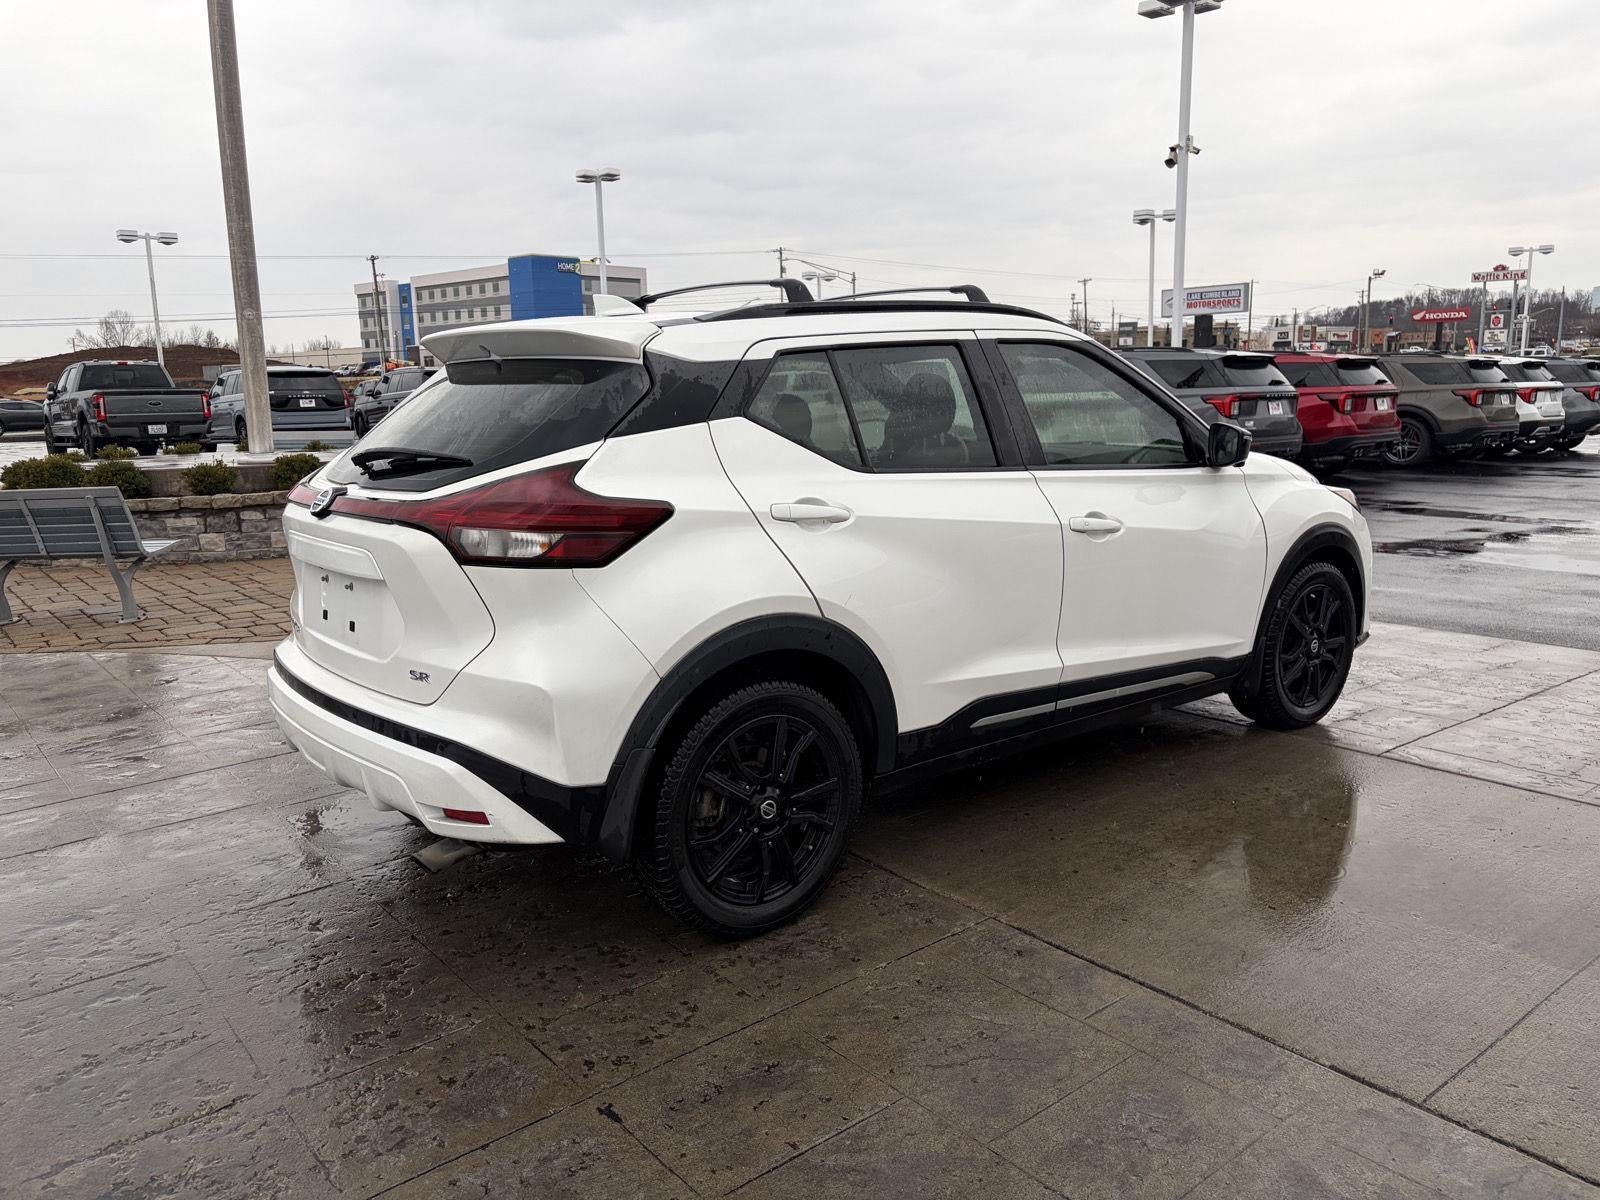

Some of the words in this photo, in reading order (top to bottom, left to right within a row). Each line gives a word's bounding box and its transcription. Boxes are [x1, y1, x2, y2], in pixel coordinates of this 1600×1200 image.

[1473, 272, 1500, 281] Waffle
[1502, 270, 1526, 280] King
[1187, 292, 1201, 300] LAKE
[1201, 289, 1241, 299] CUMBERLAND
[1186, 298, 1241, 309] MOTORSPORTS
[1425, 311, 1468, 320] HONDA
[409, 669, 431, 684] SR
